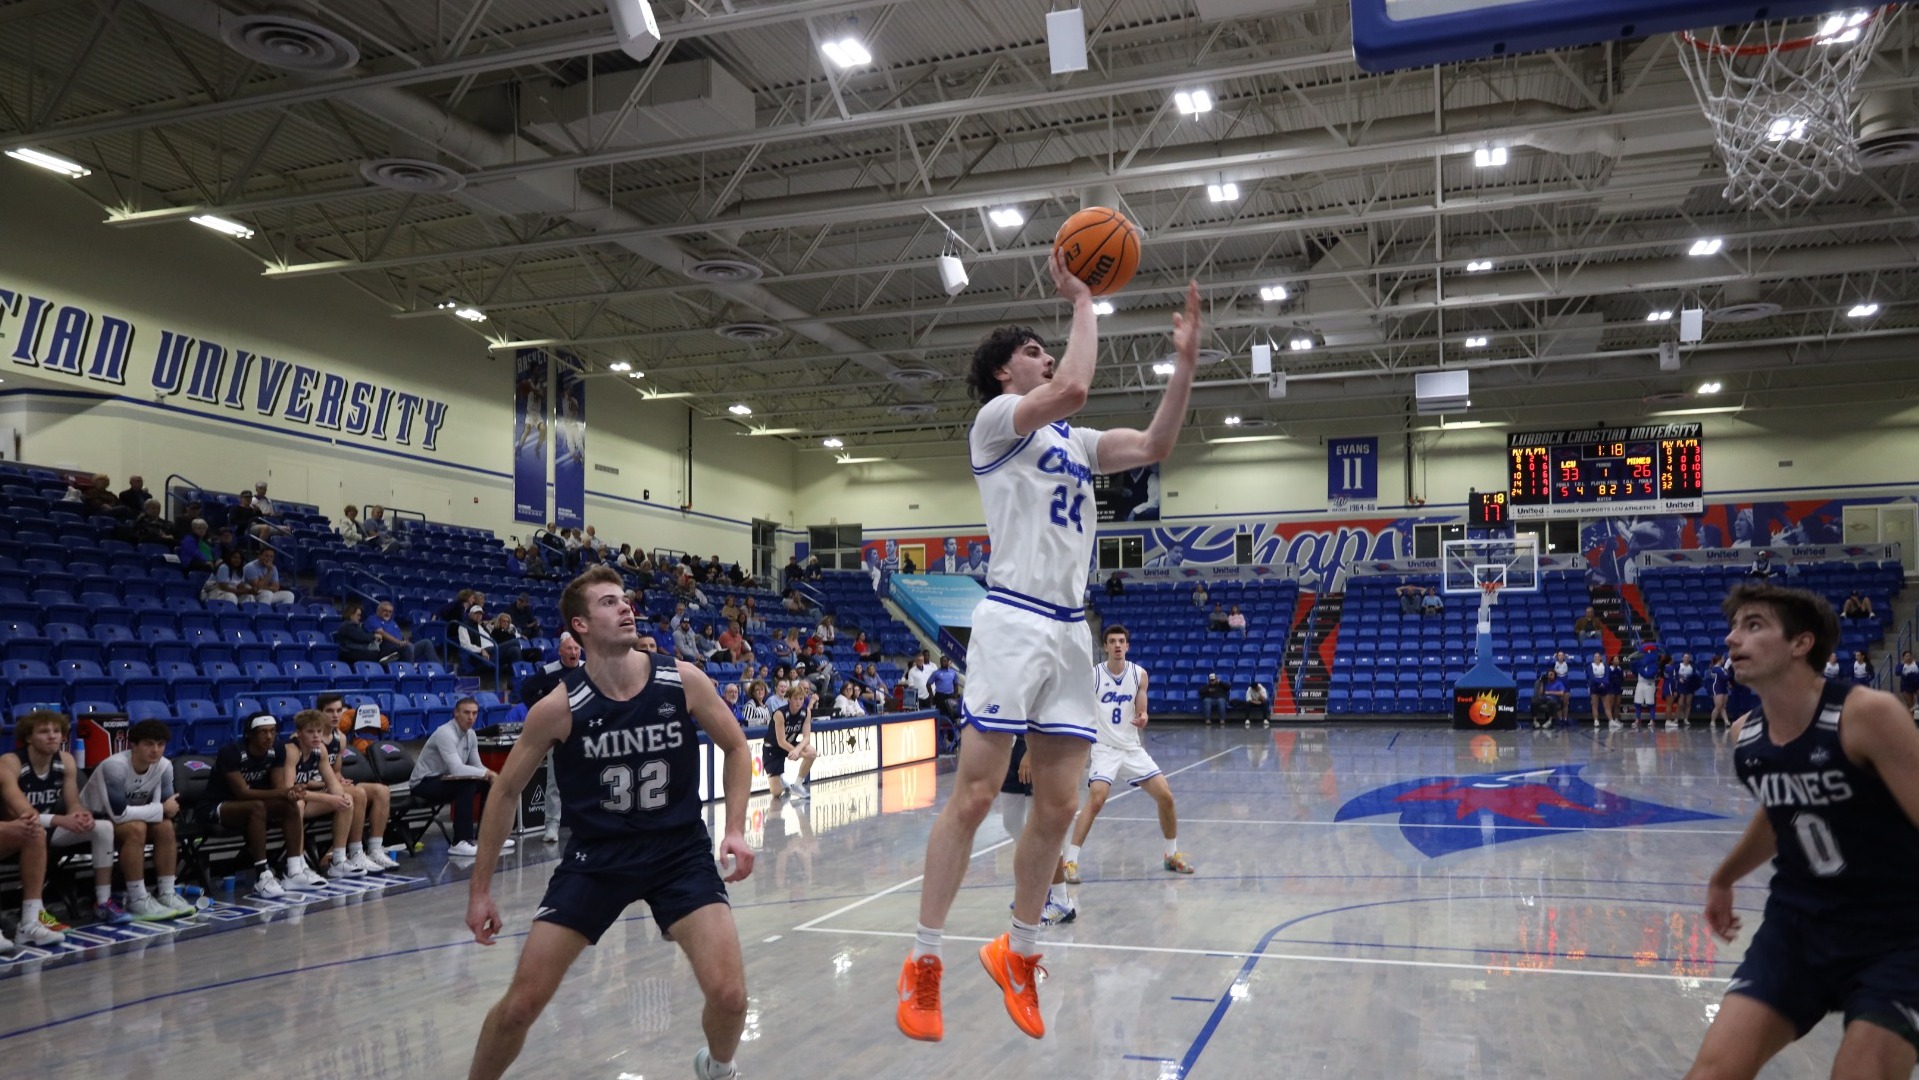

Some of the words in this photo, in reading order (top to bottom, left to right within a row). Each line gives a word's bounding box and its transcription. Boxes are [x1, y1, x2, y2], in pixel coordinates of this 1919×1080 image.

[151, 329, 448, 450] UNIVERSITY
[1511, 432, 1565, 447] LUBBOCK
[1567, 428, 1627, 443] CHRISTIAN
[1630, 423, 1699, 440] UNIVERSITY
[1336, 444, 1370, 455] EVANS
[1598, 444, 1623, 456] 1:18
[1560, 460, 1576, 468] LCU
[1634, 464, 1651, 478] 26
[1342, 458, 1362, 490] 11
[1562, 468, 1578, 480] 33
[1604, 468, 1608, 477] 1
[1562, 486, 1568, 496] 5
[1576, 486, 1584, 496] 4
[1599, 484, 1606, 494] 8
[1610, 484, 1616, 494] 2
[1626, 484, 1632, 494] 3
[1644, 483, 1652, 492] 5
[1484, 493, 1504, 504] 1:18
[1050, 484, 1087, 534] 24
[1485, 505, 1500, 521] 17
[1706, 550, 1738, 558] United
[1101, 692, 1132, 706] Chaps
[1112, 708, 1122, 724] 8
[582, 720, 683, 758] MINES
[815, 726, 871, 758] LUBBOCK
[600, 758, 670, 814] 32
[1747, 770, 1854, 807] MINES
[1791, 811, 1847, 878] 0
